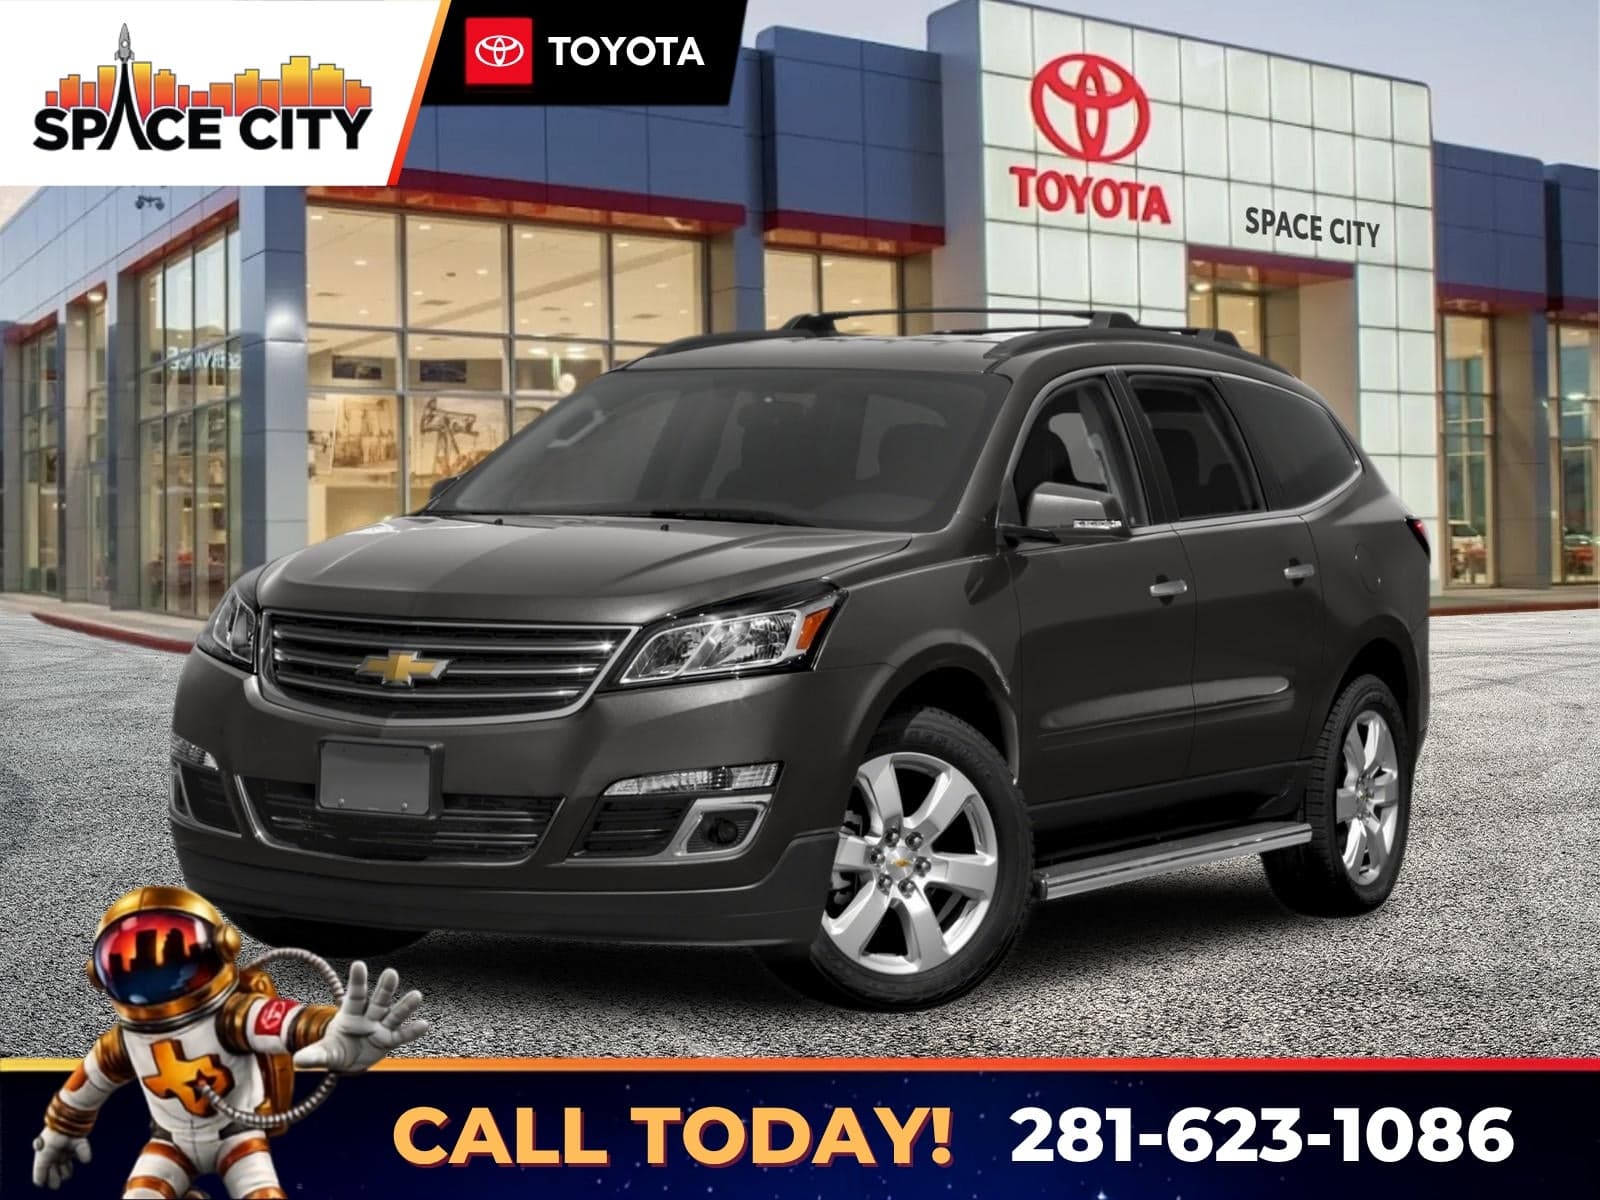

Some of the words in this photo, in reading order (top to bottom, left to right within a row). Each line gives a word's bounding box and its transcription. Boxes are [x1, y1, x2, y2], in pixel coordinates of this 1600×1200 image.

[1009, 166, 1171, 224] TOYOTA
[1245, 206, 1323, 242] SPACE
[1329, 217, 1381, 248] CITY
